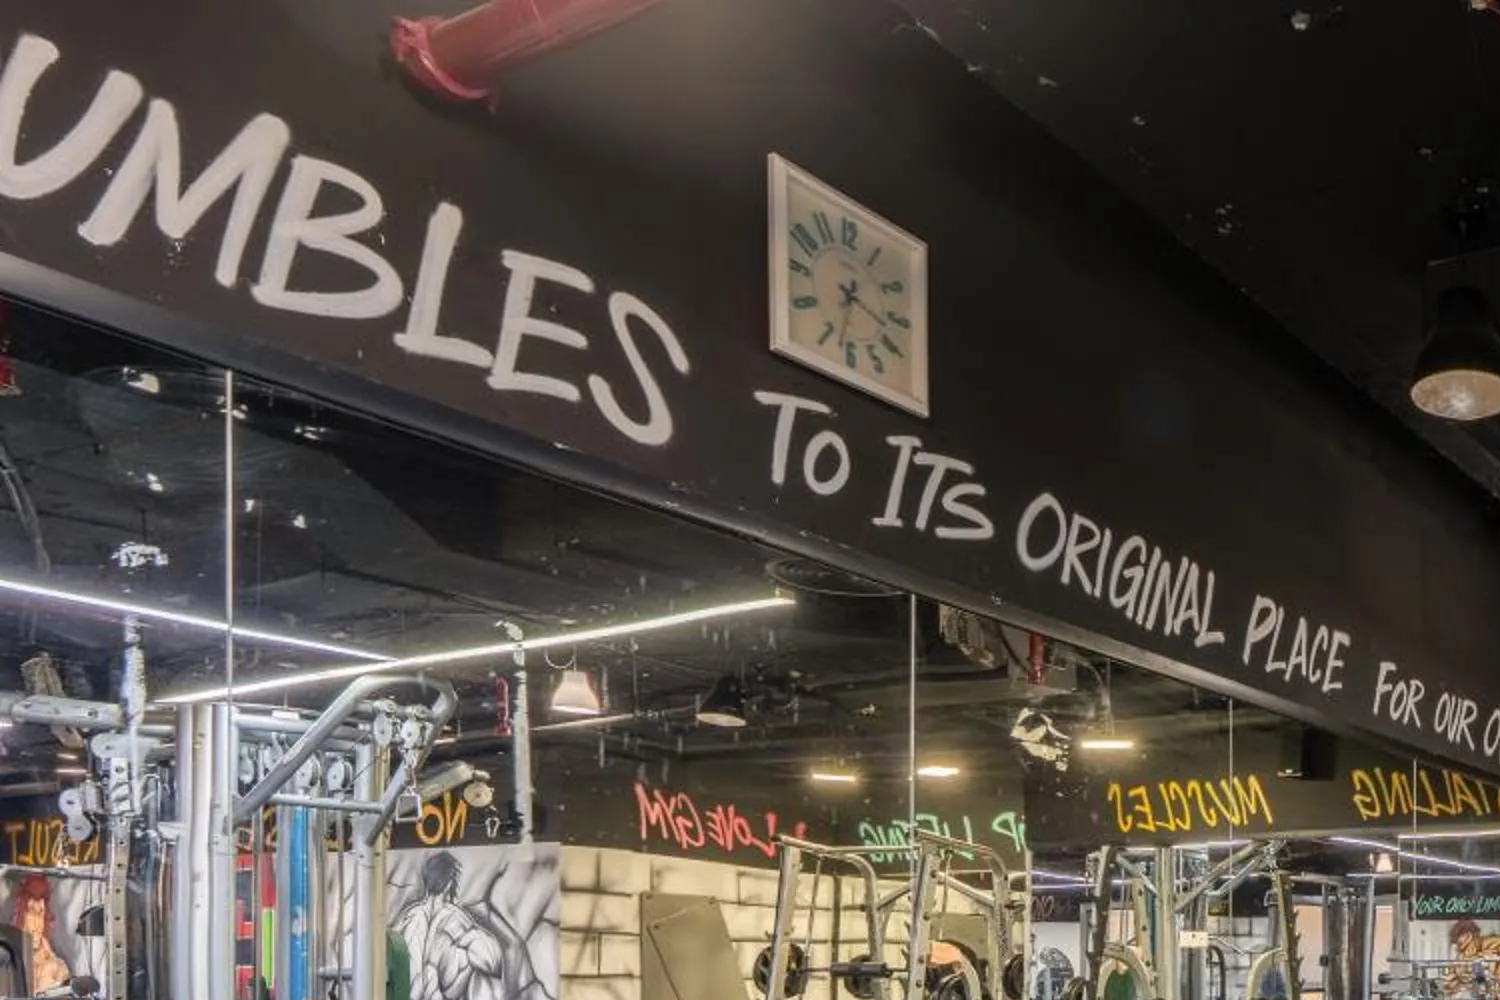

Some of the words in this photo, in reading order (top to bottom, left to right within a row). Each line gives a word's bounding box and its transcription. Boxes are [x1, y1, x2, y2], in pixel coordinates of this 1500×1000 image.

[0, 32, 690, 446] UMBLES
[753, 390, 851, 496] TO
[872, 435, 994, 540] ITS
[1015, 492, 1225, 648] ORIGINAL
[1242, 594, 1351, 693] PLACE
[1372, 662, 1426, 728] FOR
[1434, 691, 1476, 751] OUR
